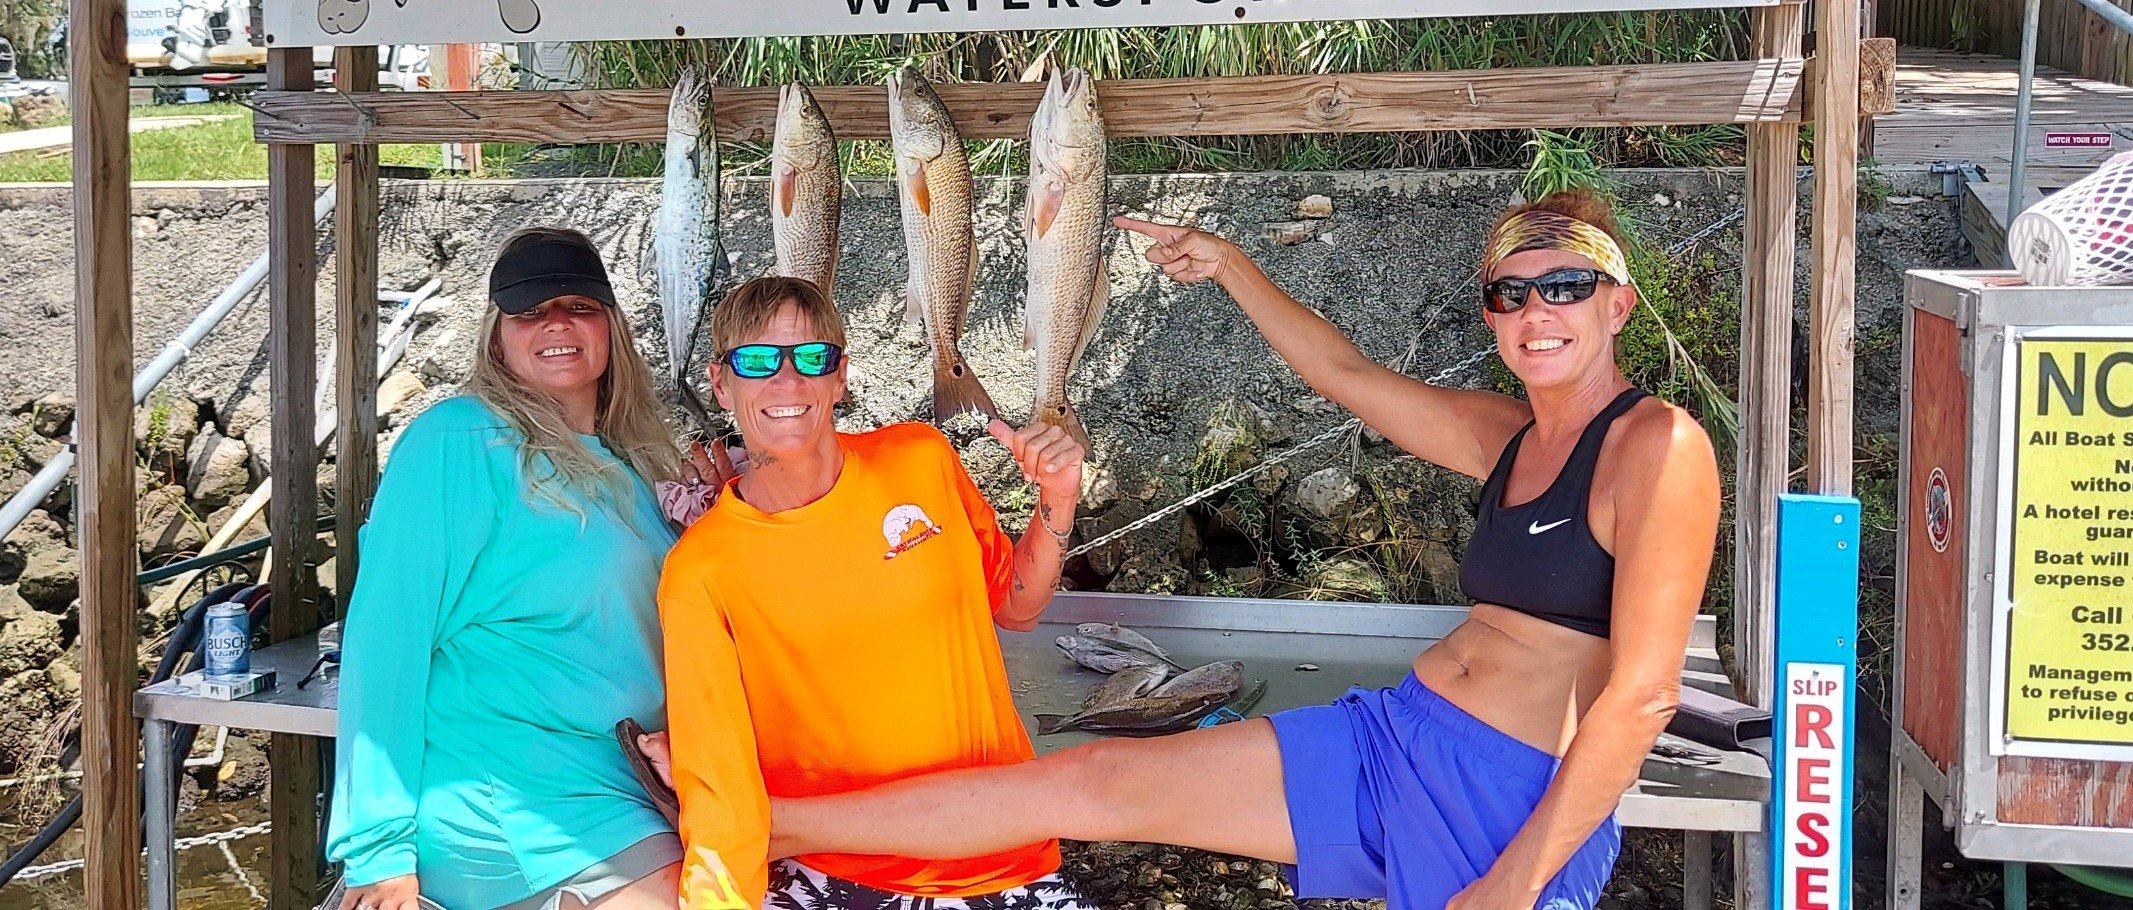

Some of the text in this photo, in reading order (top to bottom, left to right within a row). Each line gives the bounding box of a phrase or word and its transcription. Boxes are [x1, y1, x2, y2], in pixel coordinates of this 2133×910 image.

[131, 8, 162, 18] ozen
[131, 28, 164, 37] ouve
[2048, 136, 2110, 144] WATCH YOUR STEP
[2029, 431, 2057, 445] All
[2066, 431, 2115, 446] Boat
[2115, 459, 2133, 474] N
[2071, 478, 2133, 492] witho
[2023, 504, 2038, 518] A
[2045, 505, 2100, 519] hotel
[2086, 526, 2133, 541] guar
[2034, 550, 2129, 566] Boat will
[2034, 573, 2125, 588] expense
[2071, 606, 2122, 624] Call
[208, 636, 247, 650] BUSCH
[214, 649, 240, 657] LIGHT
[2029, 664, 2133, 684] Managem
[1792, 679, 1838, 696] SLIP
[2022, 685, 2042, 699] to
[2049, 686, 2117, 701] refuse
[1794, 703, 1836, 910] RESE
